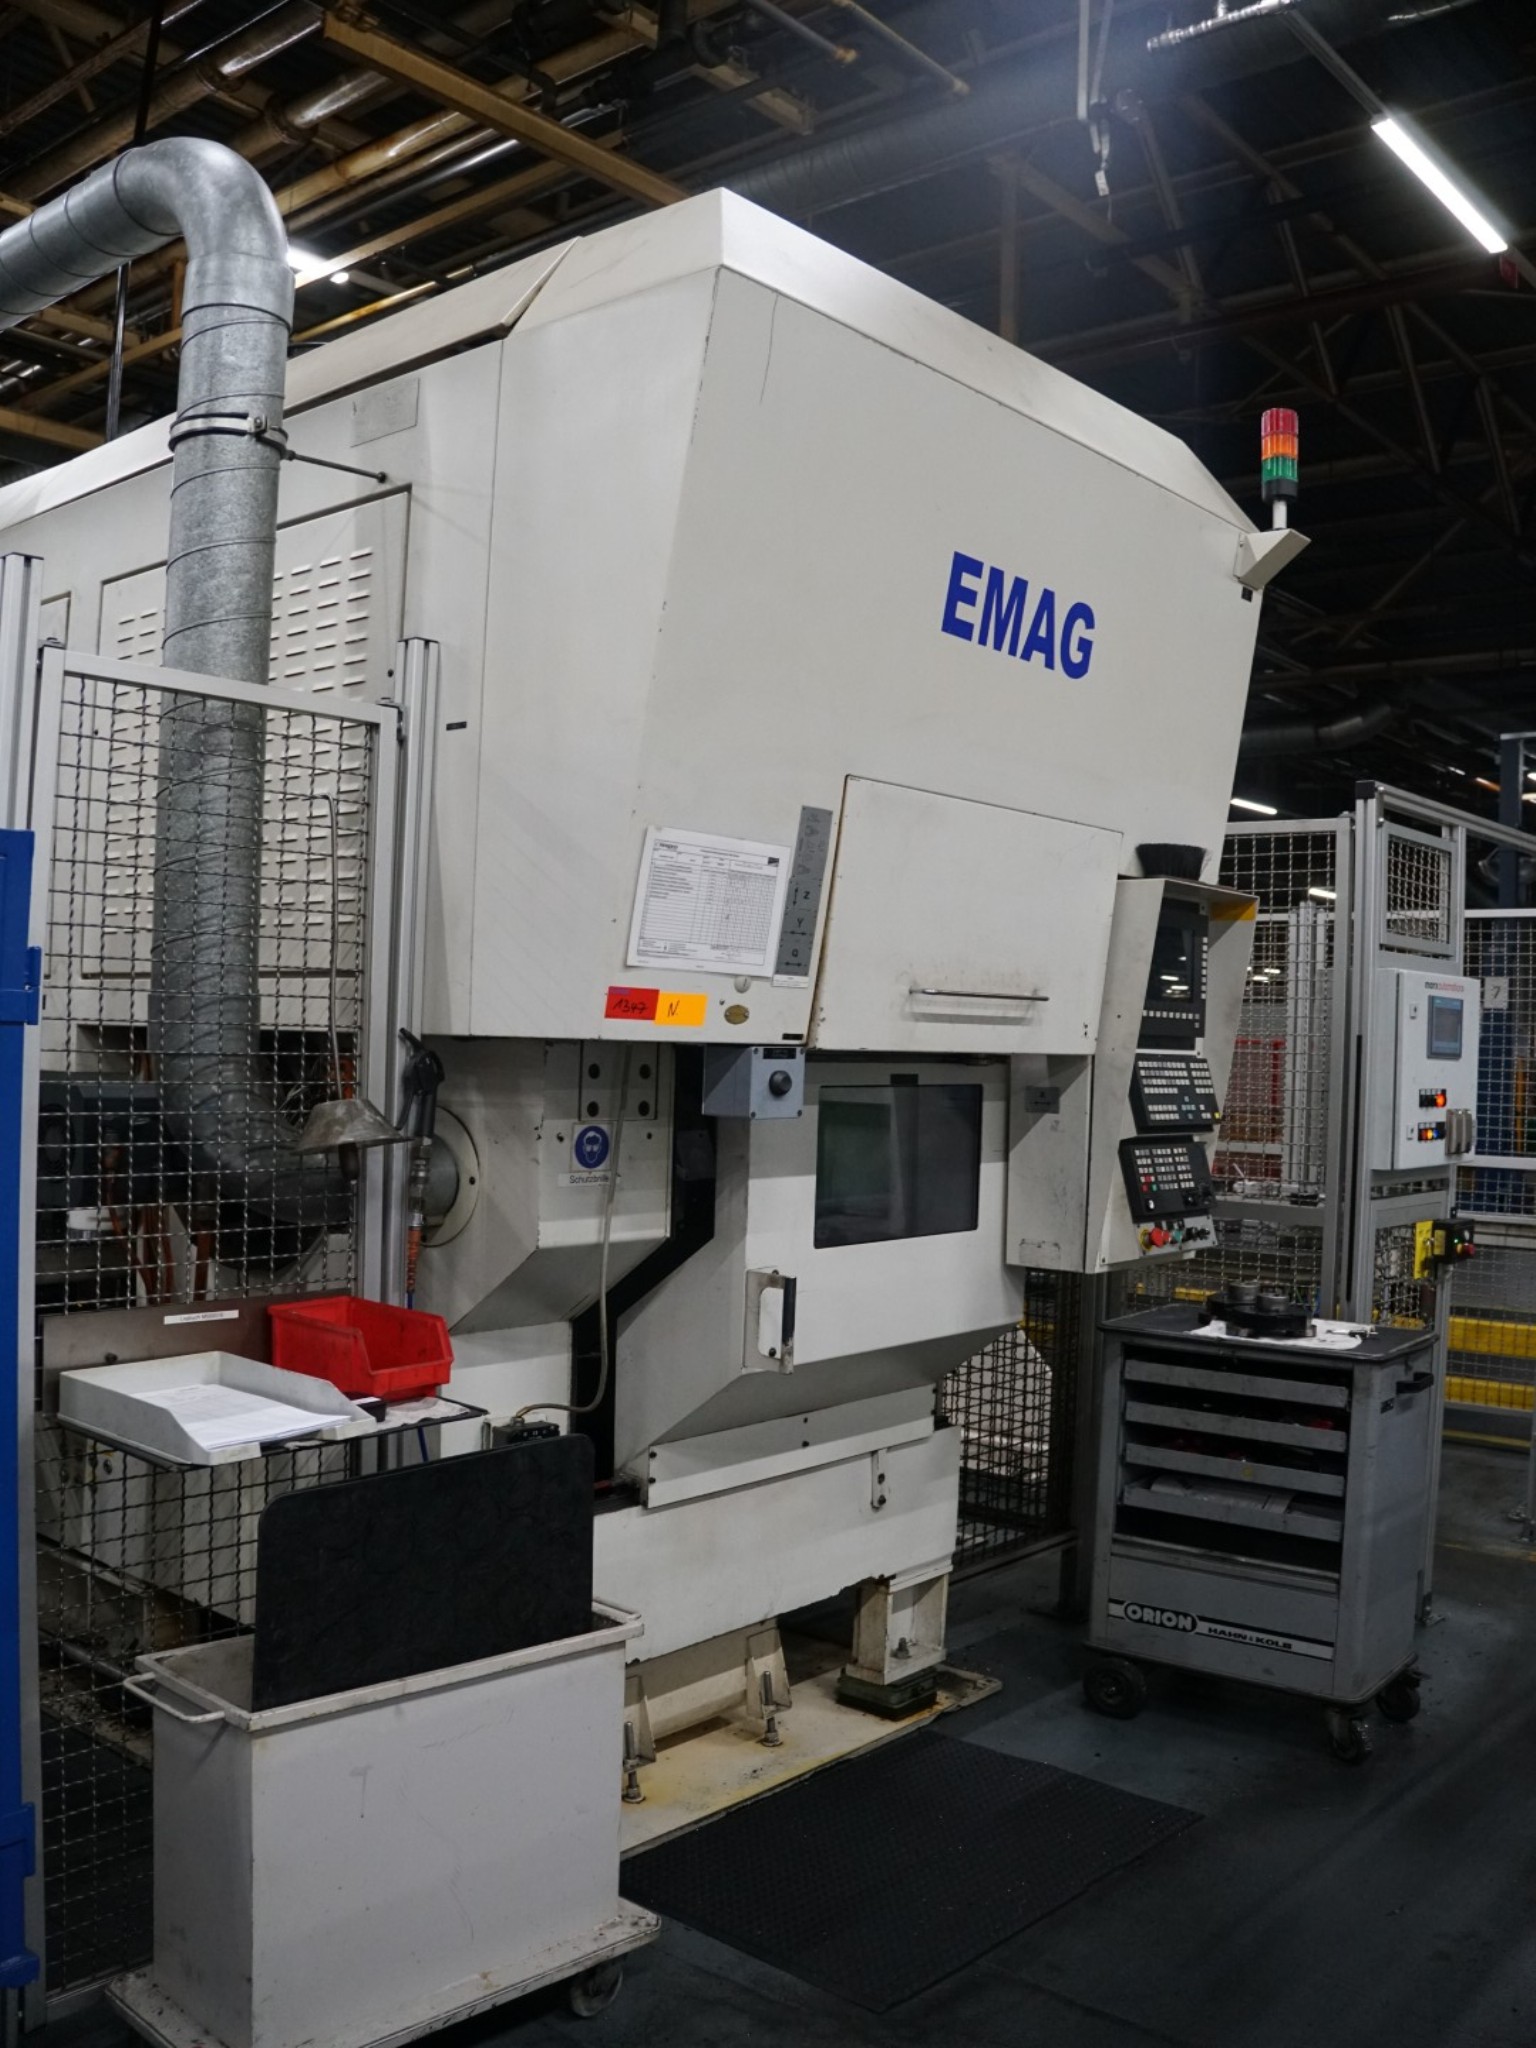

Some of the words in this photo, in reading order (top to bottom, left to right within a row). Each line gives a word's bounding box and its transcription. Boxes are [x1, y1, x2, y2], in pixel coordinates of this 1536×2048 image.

[941, 551, 1095, 679] EMAG
[803, 891, 810, 899] Z
[797, 918, 804, 928] Y
[1491, 985, 1500, 999] 7
[1127, 1604, 1192, 1631] ORION
[1208, 1627, 1248, 1640] HAHN
[1255, 1636, 1293, 1649] KOLB
